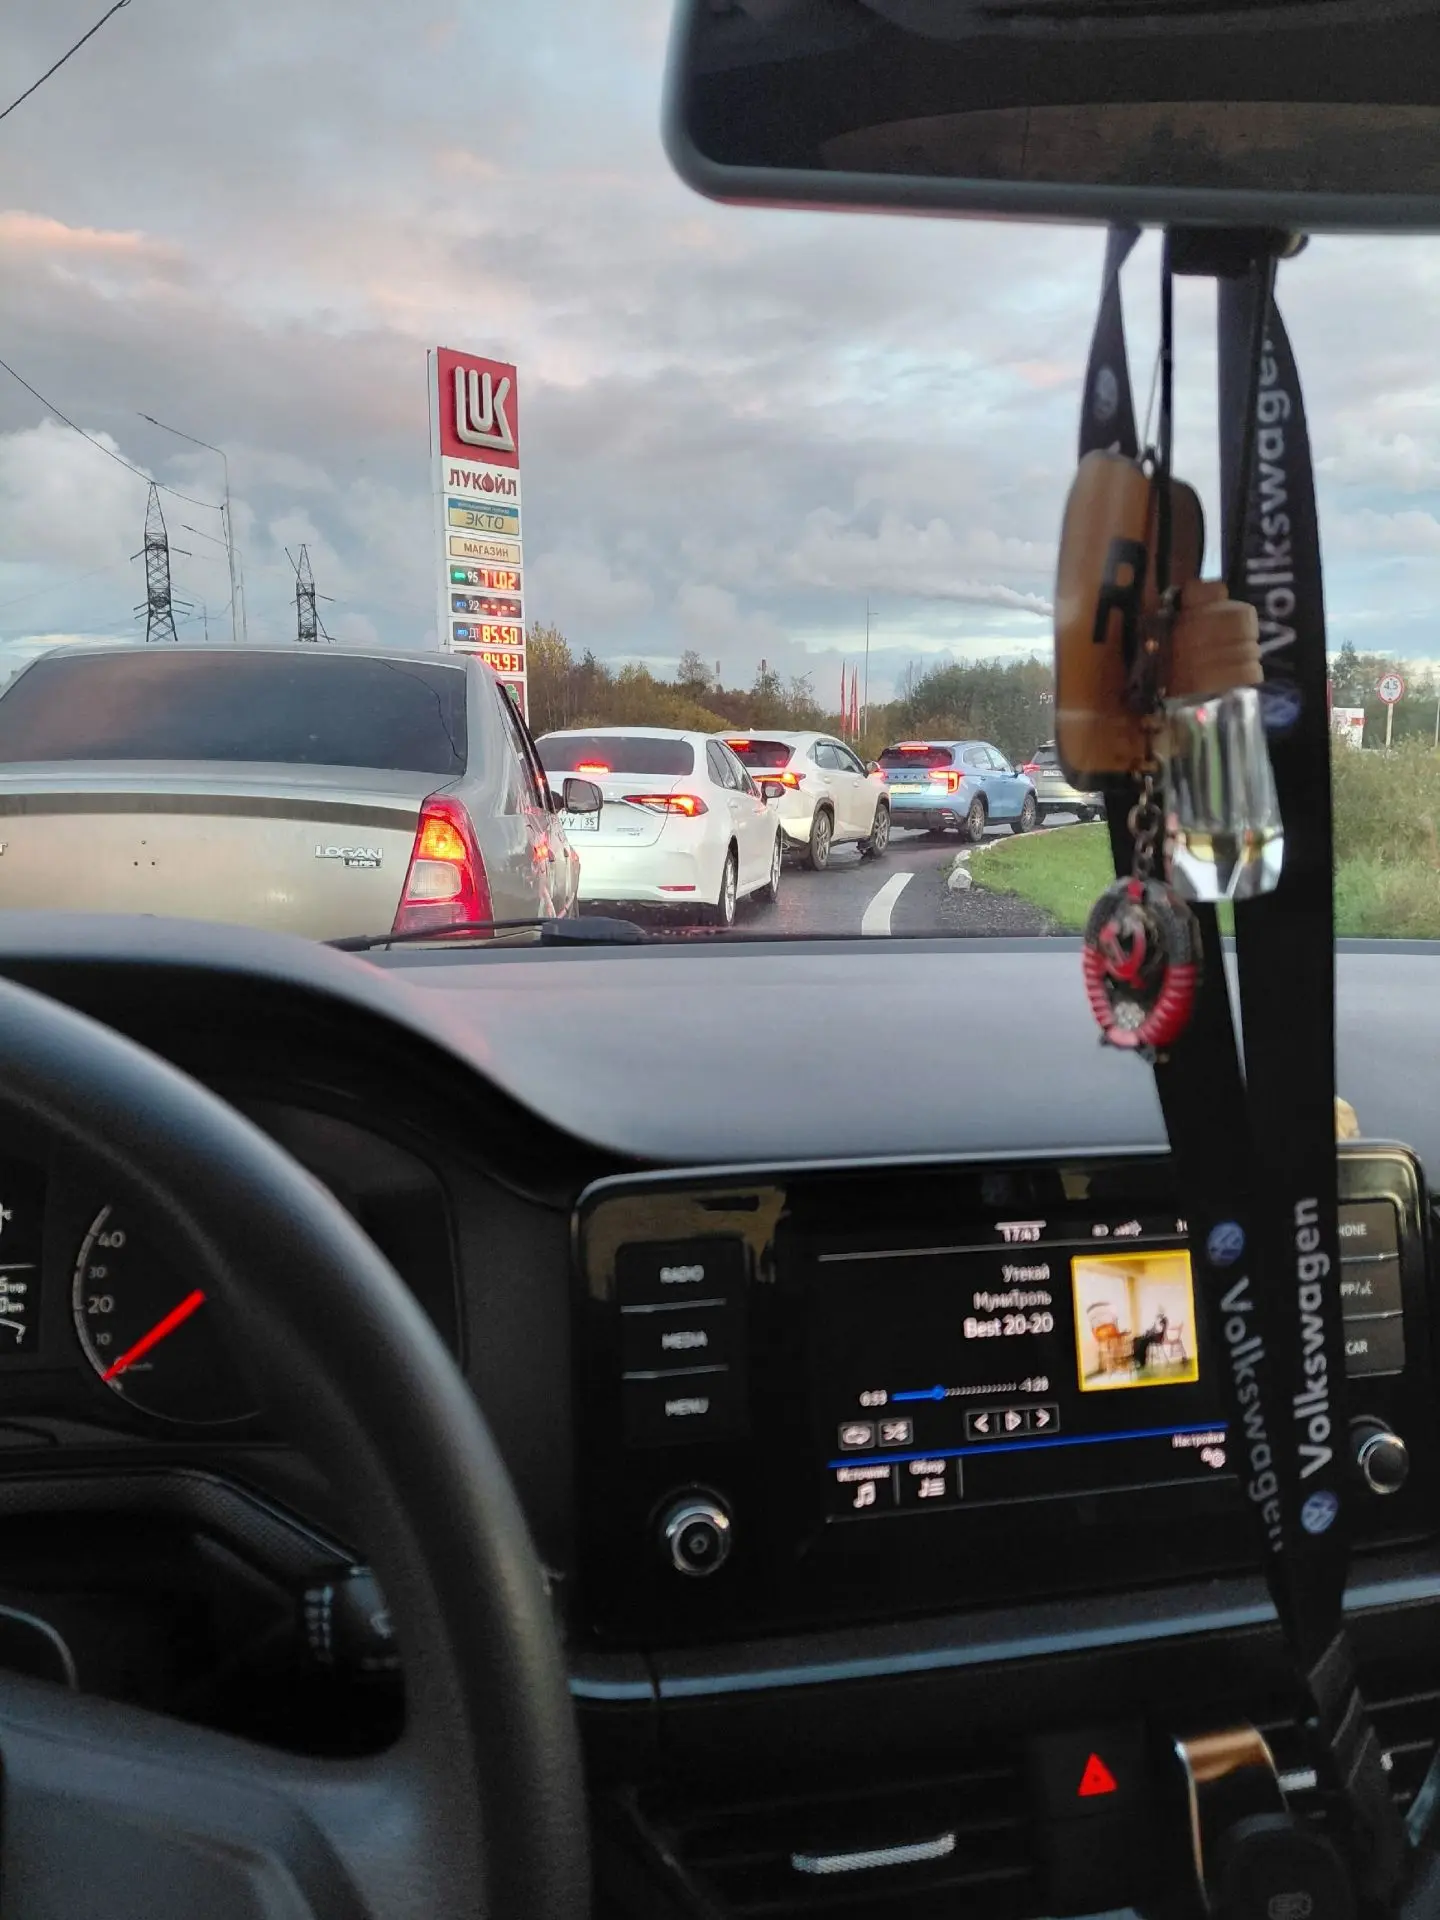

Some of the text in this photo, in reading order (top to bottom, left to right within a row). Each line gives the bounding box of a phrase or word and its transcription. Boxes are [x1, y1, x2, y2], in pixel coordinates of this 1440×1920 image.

[448, 468, 517, 497] ЛУКОЙЛ
[465, 511, 505, 530] ЭКТО
[463, 542, 509, 558] МАГАЗИН
[467, 570, 479, 584] 95
[468, 599, 480, 612] 92
[468, 627, 480, 641] ДТ
[482, 625, 518, 645] 85.50
[315, 844, 383, 860] LOGAN
[97, 1230, 126, 1248] 40
[88, 1266, 107, 1279] 30
[88, 1294, 115, 1314] 20
[963, 1311, 1054, 1339] Best 20-20
[96, 1332, 112, 1346] 10
[1293, 1196, 1334, 1479] Volkswagen
[1344, 1340, 1369, 1356] CAR
